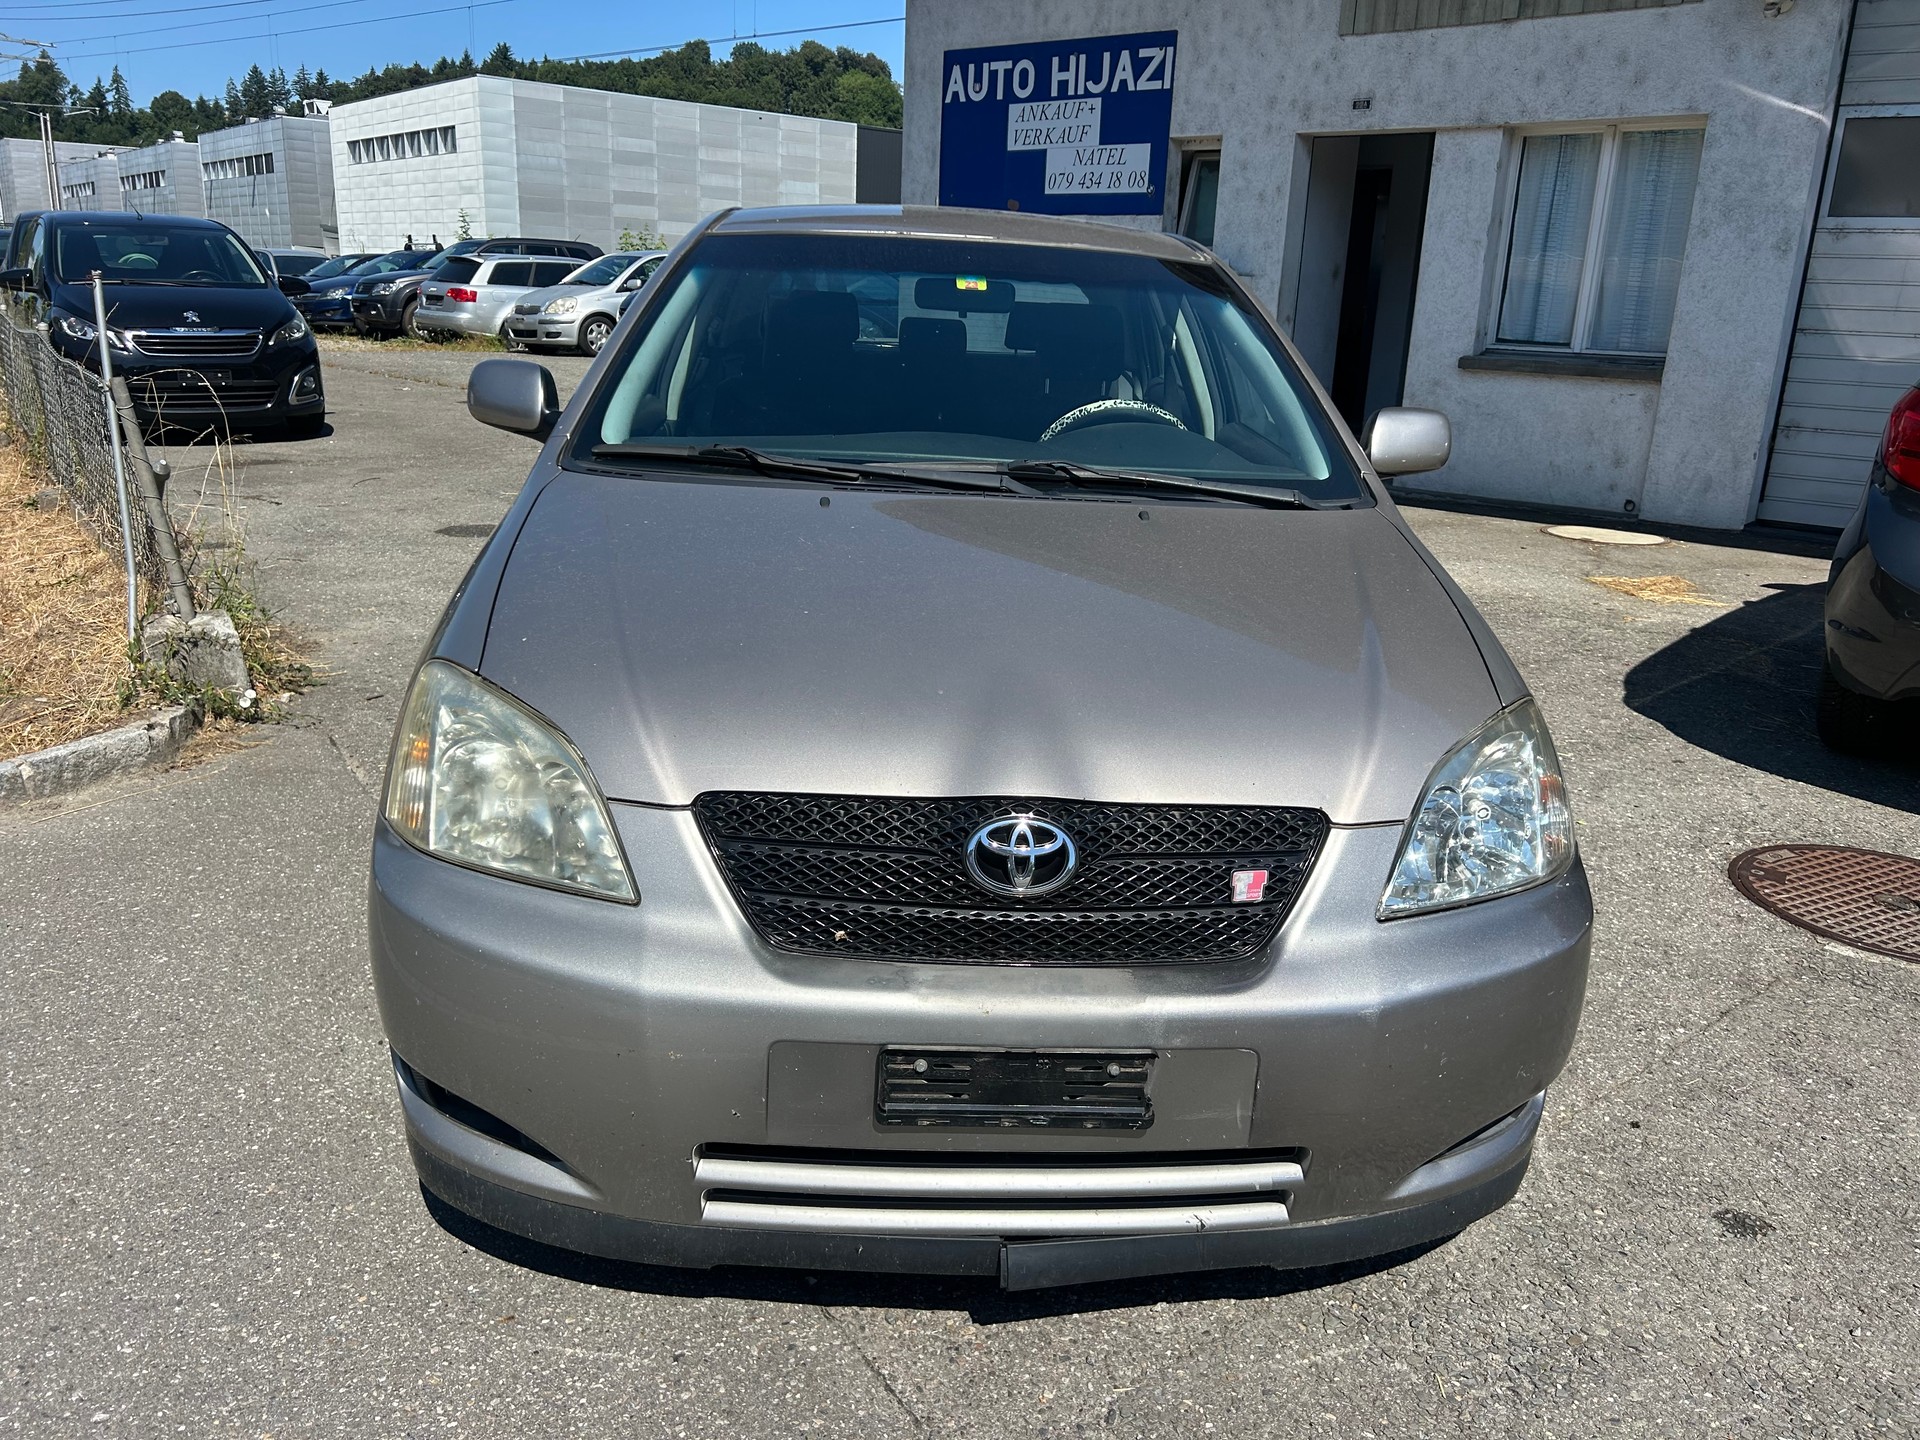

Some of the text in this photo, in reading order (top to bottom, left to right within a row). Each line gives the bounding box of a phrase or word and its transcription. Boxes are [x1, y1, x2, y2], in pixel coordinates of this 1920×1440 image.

[945, 46, 1174, 103] AUTO HIJAZI
[1014, 125, 1092, 146] VERKAUF
[1073, 148, 1127, 167] NATEL
[1048, 170, 1147, 190] 079 434 18 08
